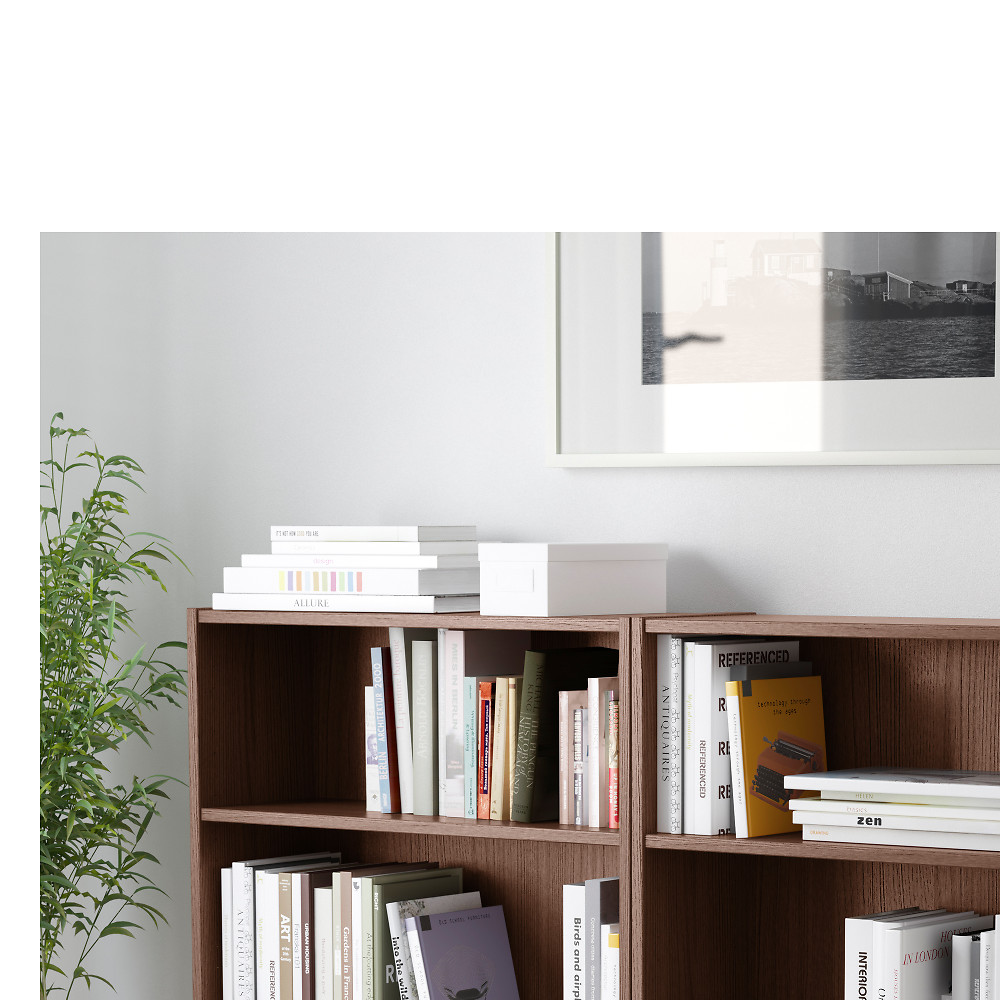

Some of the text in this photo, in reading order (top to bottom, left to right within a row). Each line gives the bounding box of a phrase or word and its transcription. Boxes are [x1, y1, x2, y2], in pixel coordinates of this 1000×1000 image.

[293, 599, 330, 608] ALLURE
[392, 639, 403, 677] baroque
[718, 649, 790, 668] REFERENCED
[451, 643, 459, 730] MIES IN BERLIN
[525, 683, 535, 712] KING
[757, 697, 811, 709] technology through
[785, 707, 797, 715] ages
[373, 663, 388, 780] BERLIN ARCHITEKTUR 2000
[416, 709, 427, 759] ARNOLD
[660, 685, 670, 783] ANTIQUAIRES
[520, 716, 532, 764] HISTORY
[526, 742, 537, 788] PENGUIN
[699, 740, 707, 799] REFERENCED
[857, 816, 882, 826] zen
[280, 914, 291, 942] ART
[573, 917, 582, 947] Birds
[236, 910, 245, 997] ANTIQUAIRES
[392, 936, 402, 957] into
[573, 949, 582, 972] and
[902, 946, 950, 966] IN LONDON
[343, 965, 350, 974] in
[394, 959, 404, 976] the
[398, 978, 409, 1000] wild
